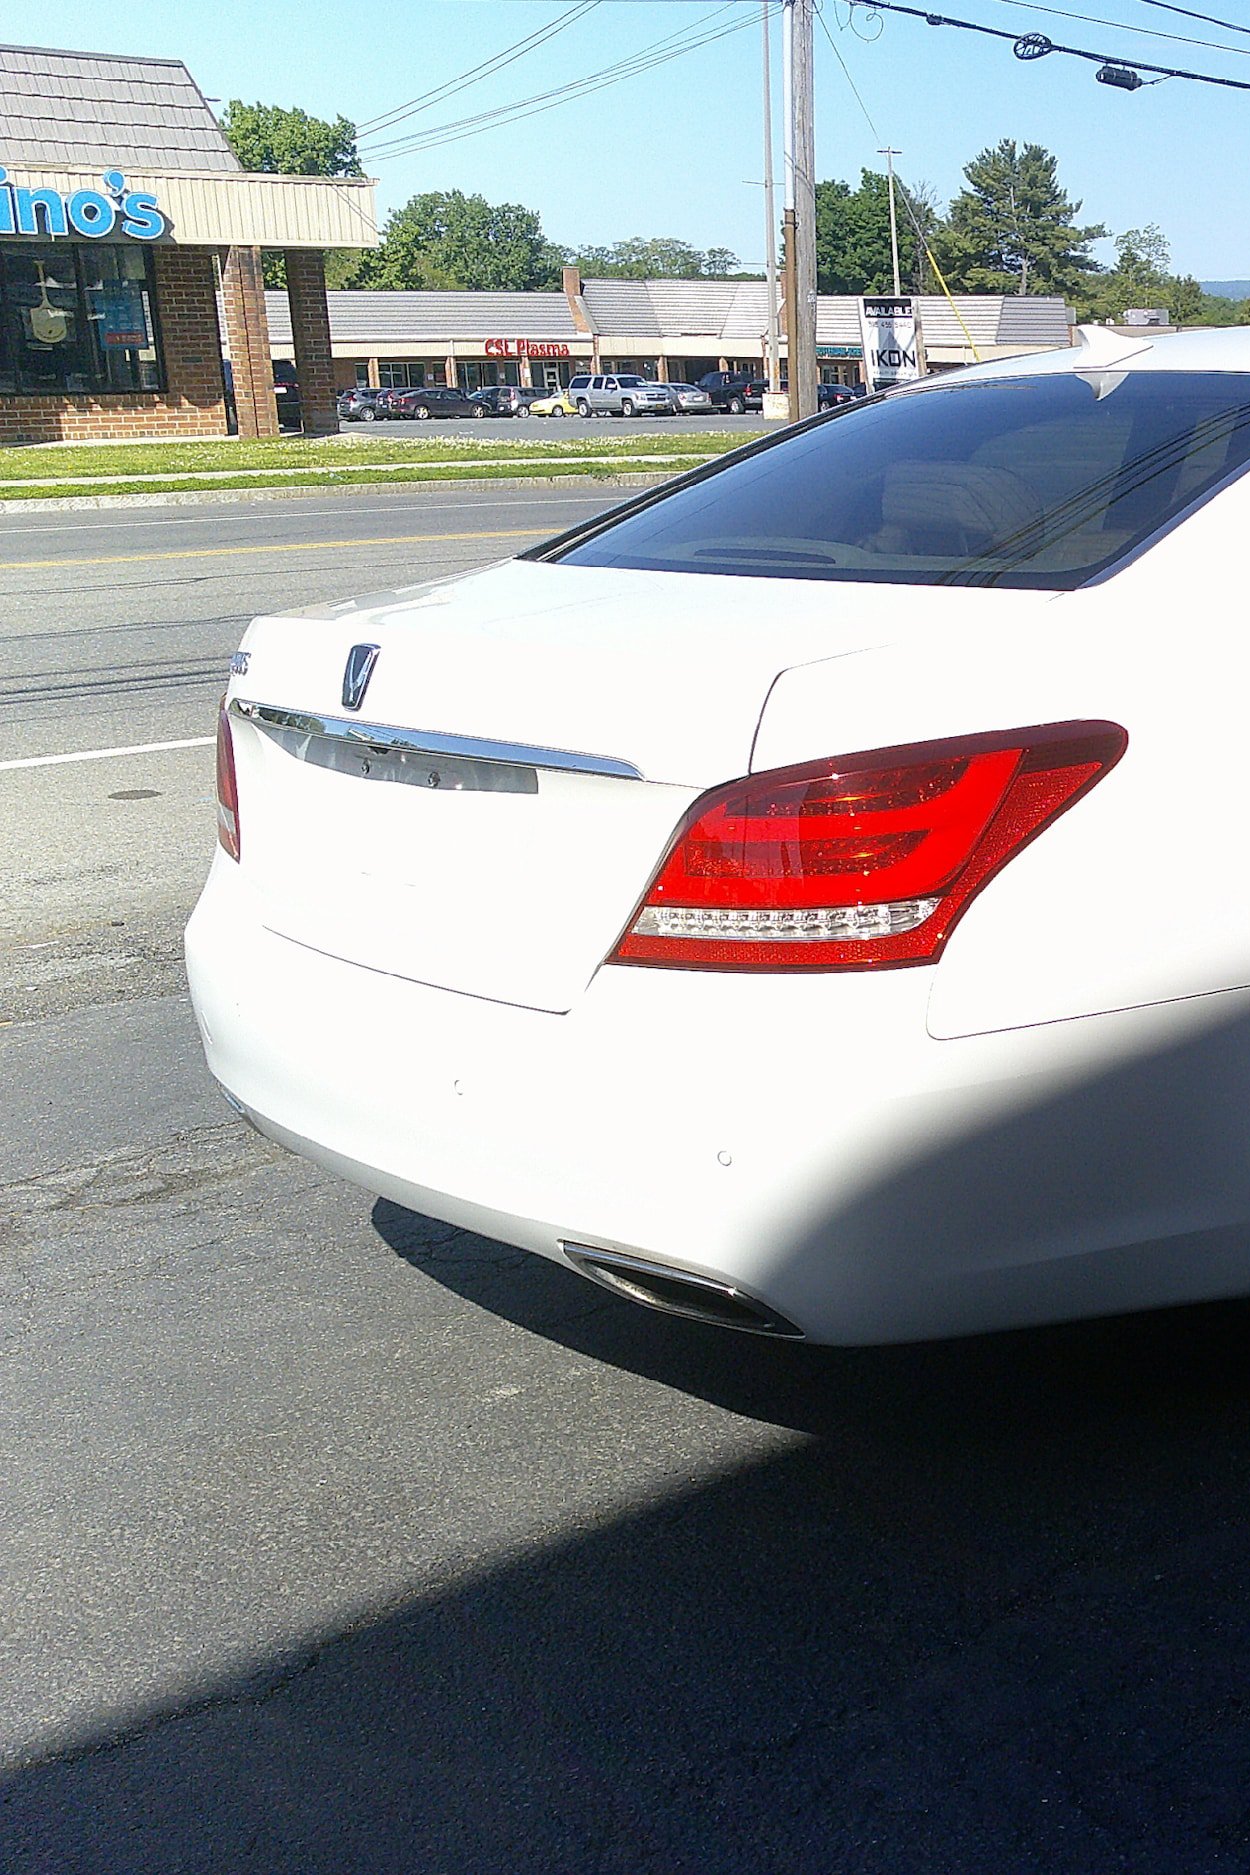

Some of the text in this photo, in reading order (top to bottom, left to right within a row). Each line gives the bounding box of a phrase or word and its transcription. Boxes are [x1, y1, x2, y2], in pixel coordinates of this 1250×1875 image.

[866, 305, 912, 317] AVAILABLE
[484, 337, 570, 356] CSL Plasma
[870, 349, 916, 368] IKON
